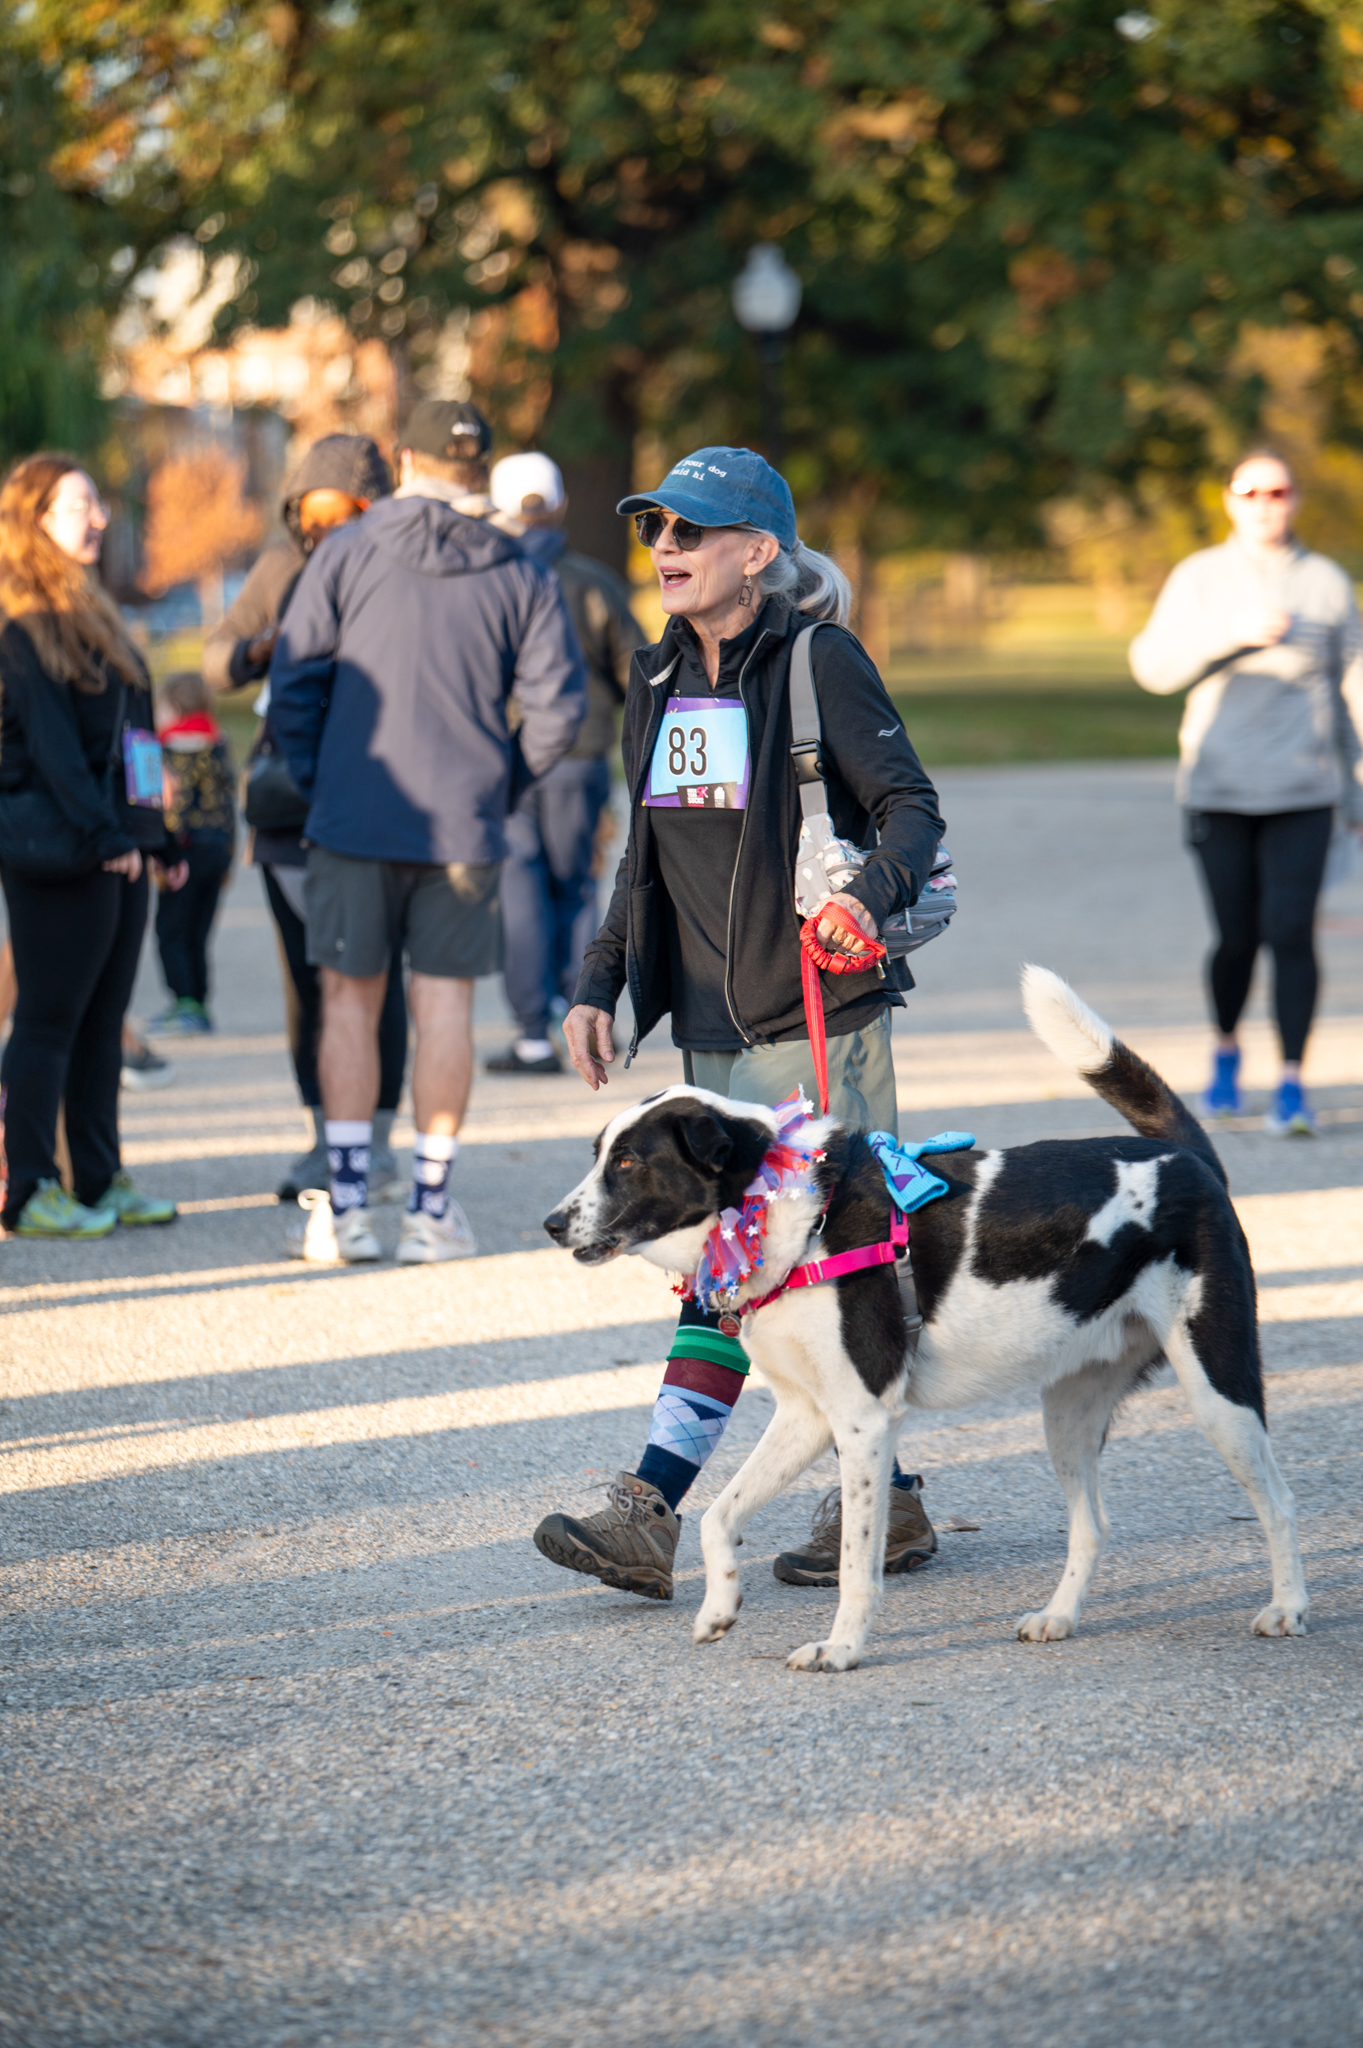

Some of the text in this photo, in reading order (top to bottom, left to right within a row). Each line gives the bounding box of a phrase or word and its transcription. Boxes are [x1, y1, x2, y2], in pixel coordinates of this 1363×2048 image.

[683, 460, 704, 468] your
[708, 465, 727, 478] dog
[692, 470, 705, 481] hi
[667, 726, 708, 777] 83
